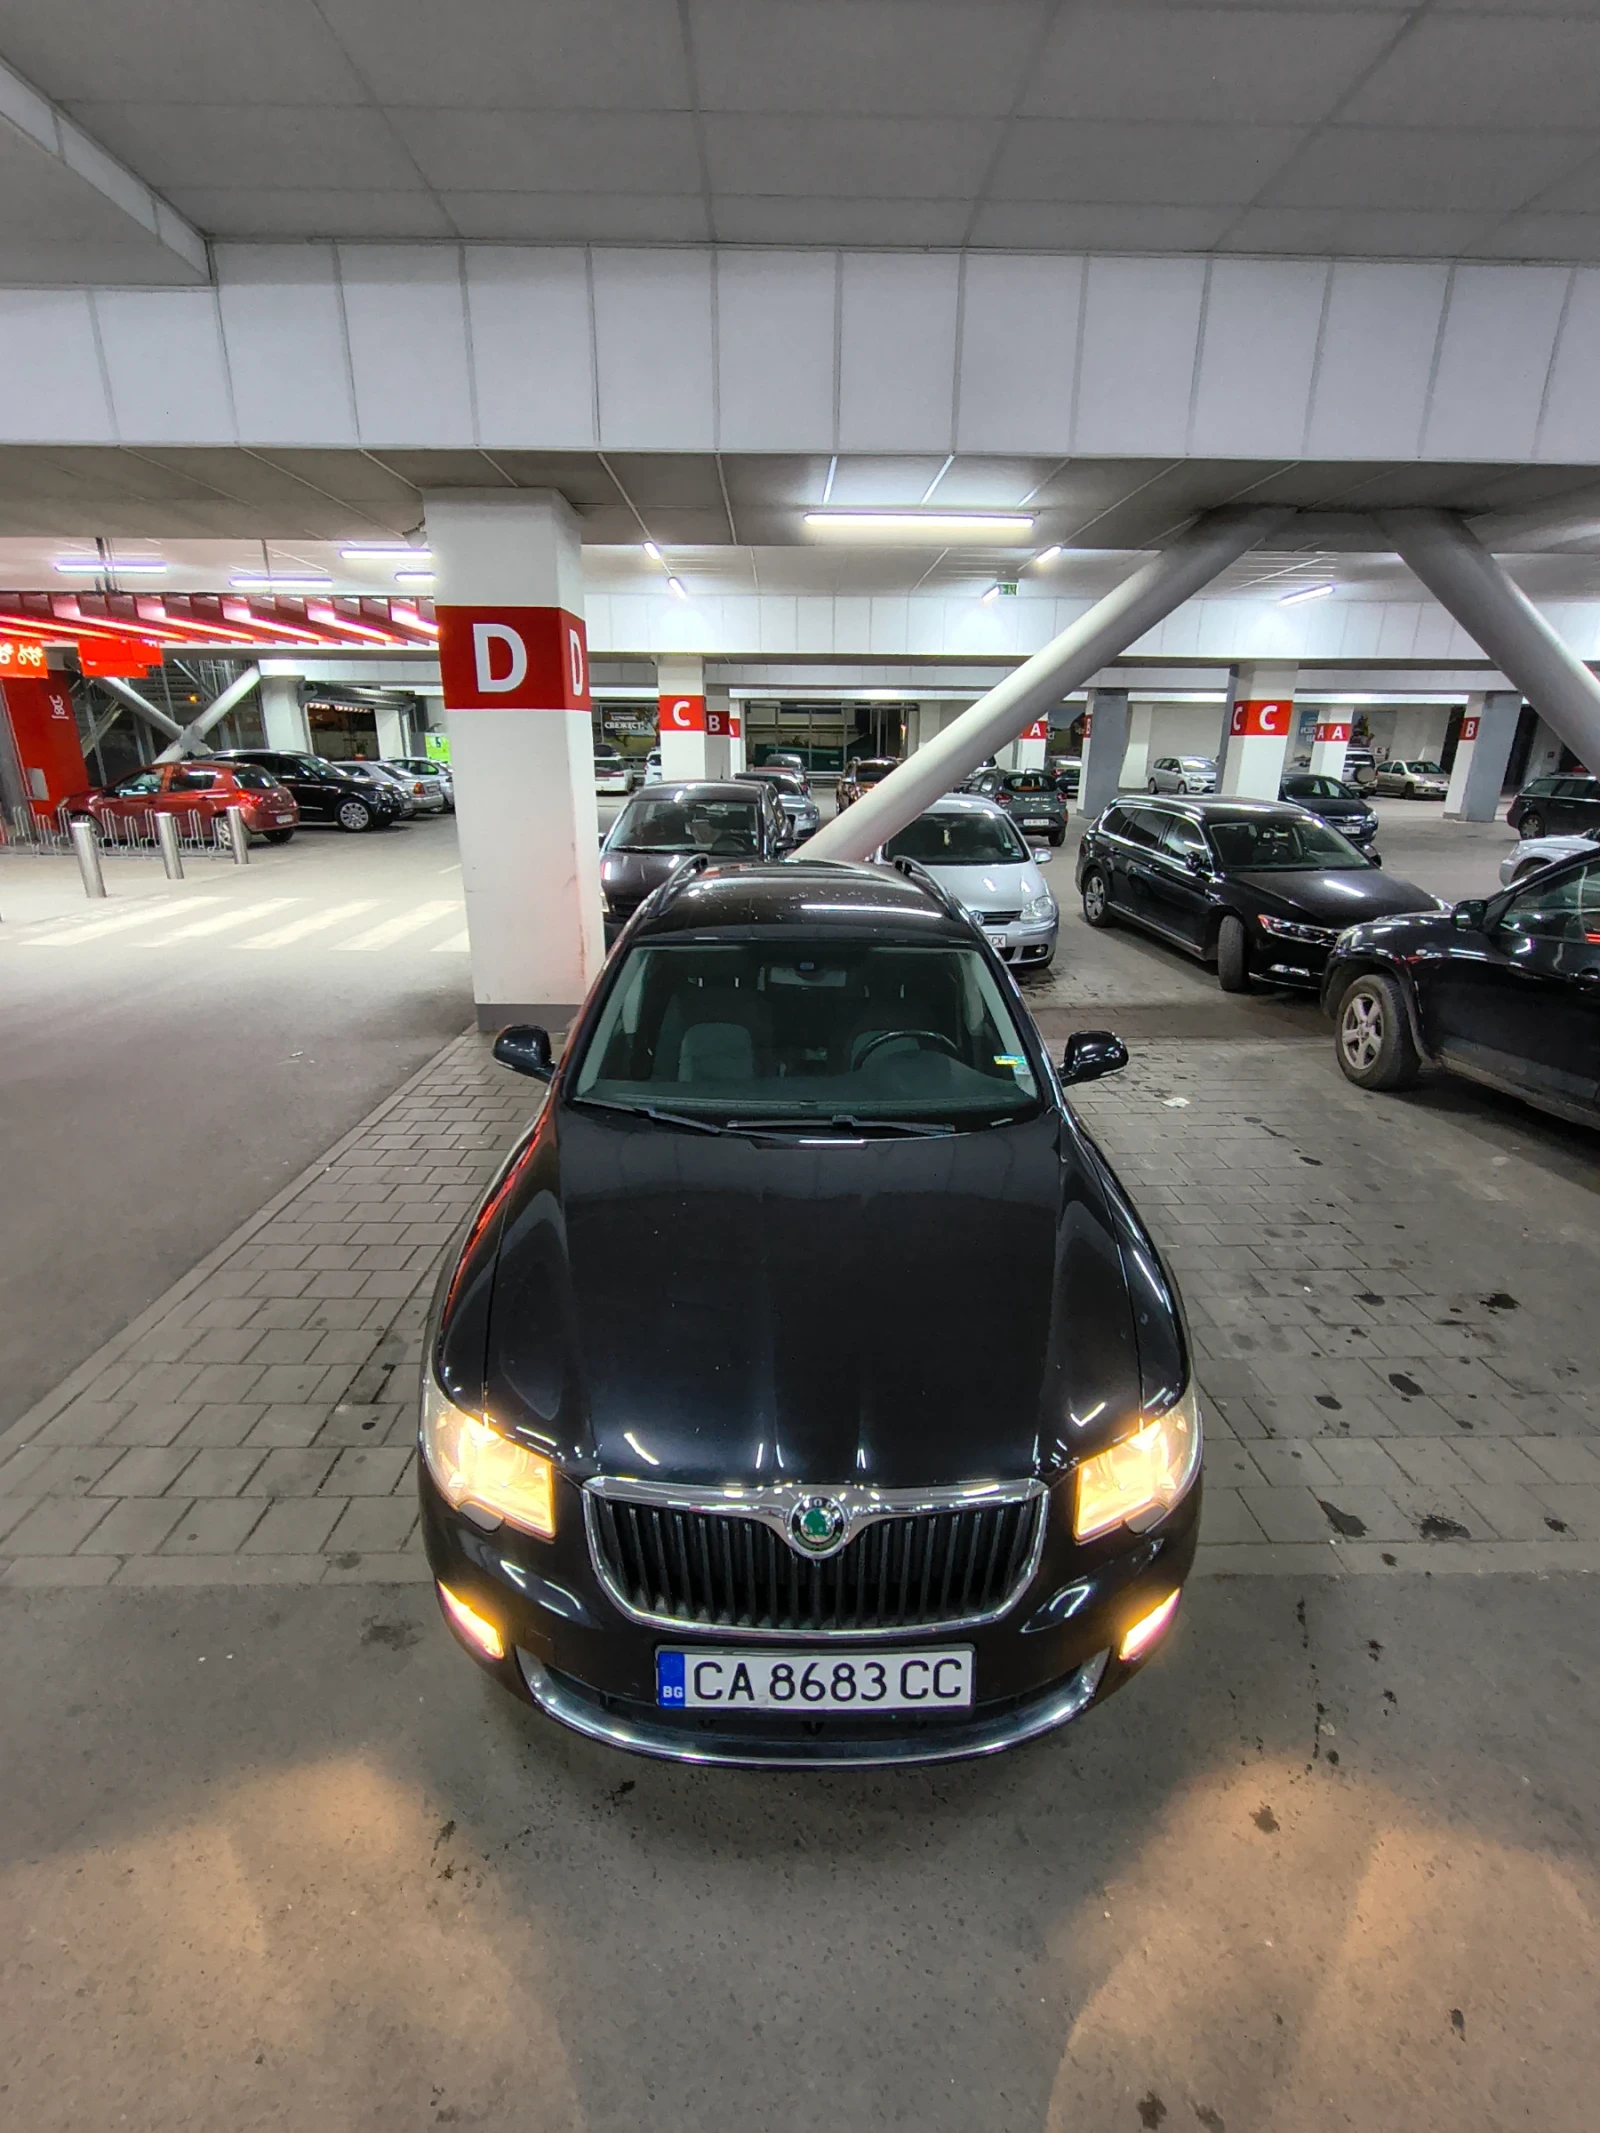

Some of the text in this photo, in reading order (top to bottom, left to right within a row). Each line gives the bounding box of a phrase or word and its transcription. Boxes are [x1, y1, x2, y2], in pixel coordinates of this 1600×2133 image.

[473, 623, 528, 693] D
[569, 628, 584, 696] D
[672, 700, 691, 727] C
[708, 714, 721, 732] B
[1233, 705, 1243, 731] C
[1259, 705, 1278, 731] C
[1030, 722, 1041, 737] A
[1317, 725, 1325, 739] A
[1331, 725, 1344, 740] A
[1465, 720, 1476, 738] B
[693, 1657, 962, 1702] CA 8683 CC
[662, 1685, 684, 1699] BG
